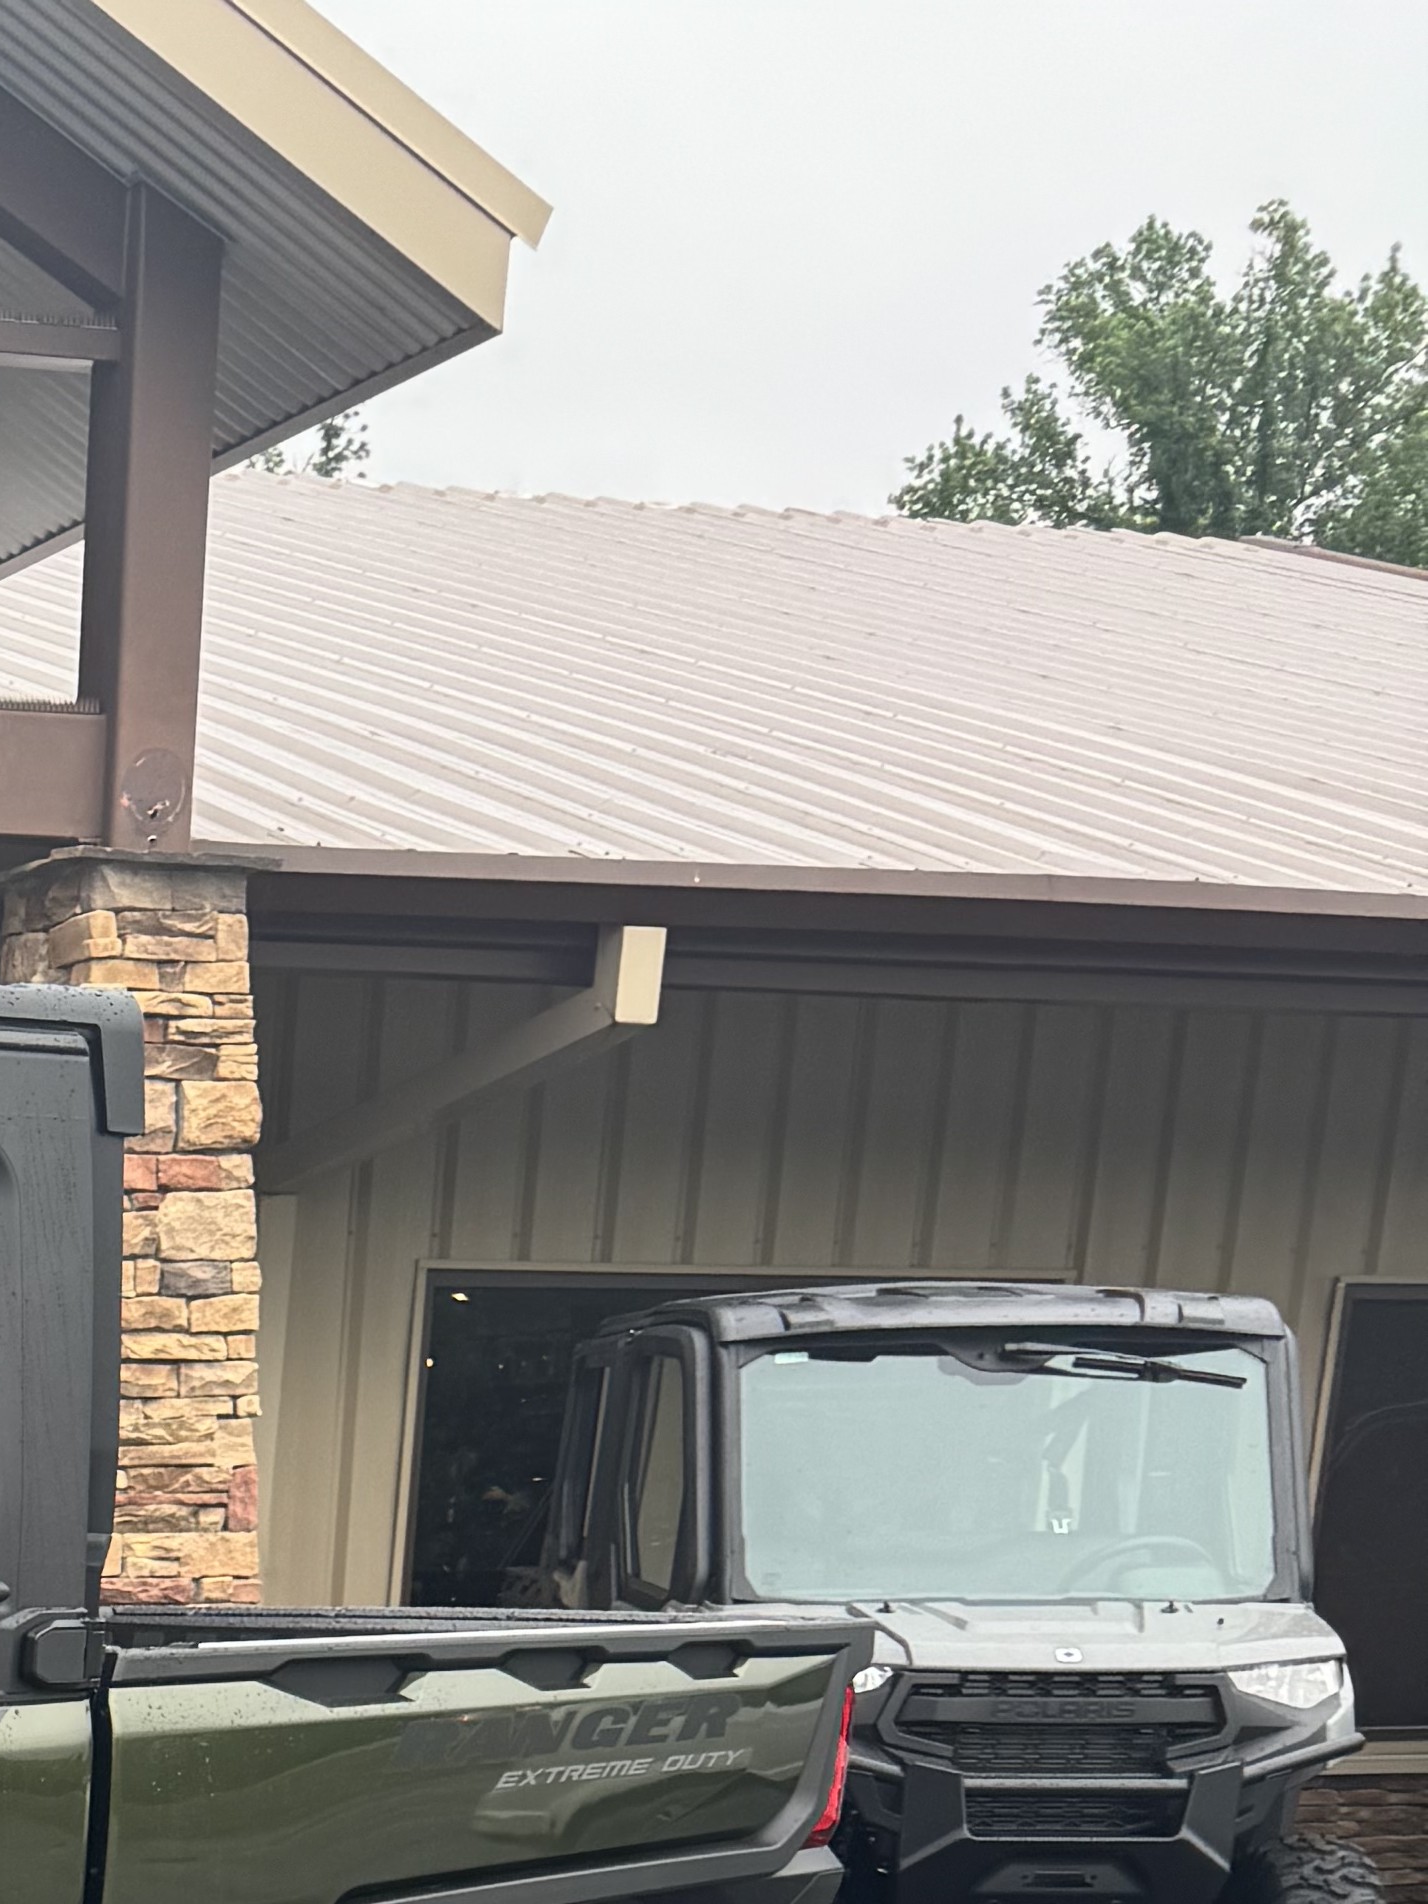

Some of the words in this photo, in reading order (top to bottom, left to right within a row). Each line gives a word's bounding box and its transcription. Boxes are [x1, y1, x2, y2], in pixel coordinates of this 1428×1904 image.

[392, 1693, 741, 1768] RANGER
[990, 1700, 1138, 1720] POLARIS
[494, 1757, 649, 1789] EXTREME
[661, 1747, 747, 1773] DUTY
